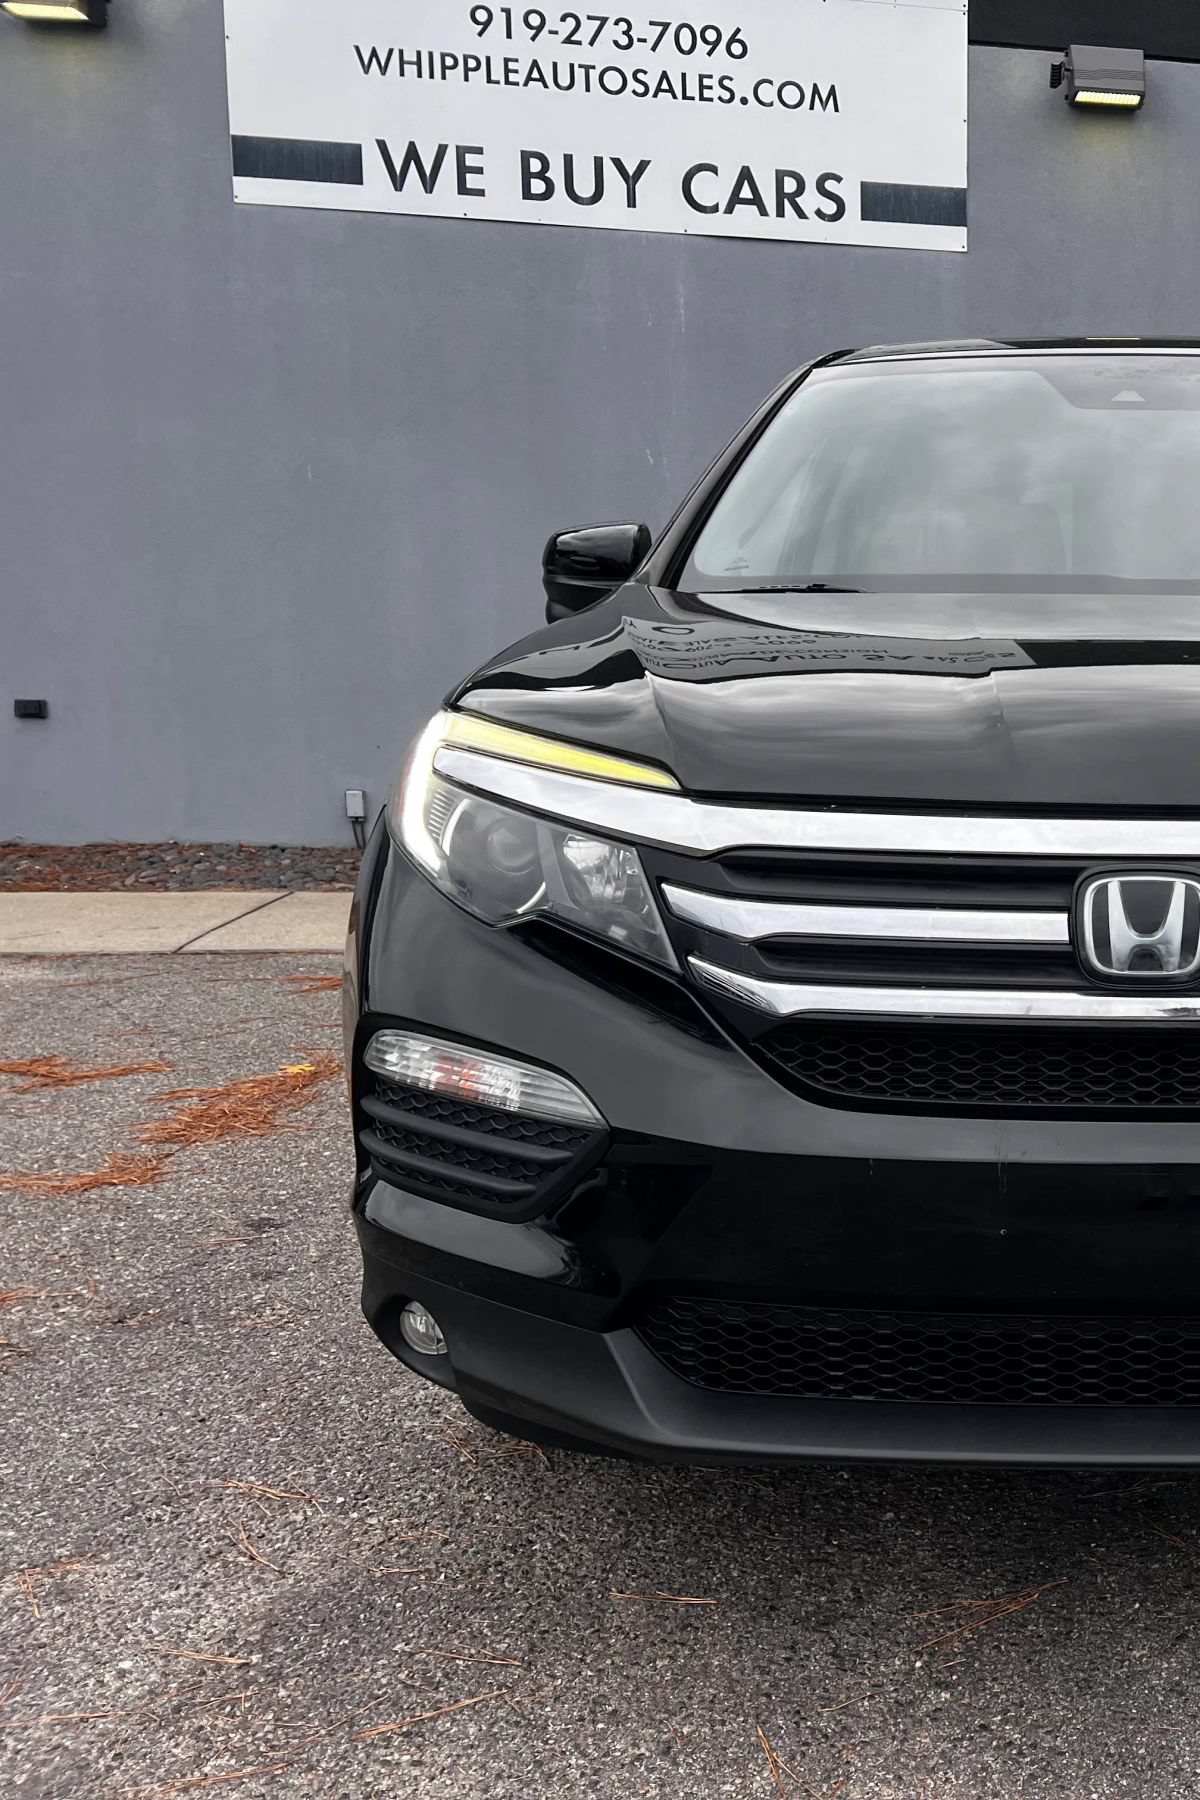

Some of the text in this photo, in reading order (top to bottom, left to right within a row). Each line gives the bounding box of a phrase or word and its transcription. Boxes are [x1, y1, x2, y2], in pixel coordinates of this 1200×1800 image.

[469, 4, 748, 60] 919-273-7096
[353, 44, 840, 113] WHIPPLEAUTOSALES.COM
[375, 138, 847, 223] WE BUY CARS
